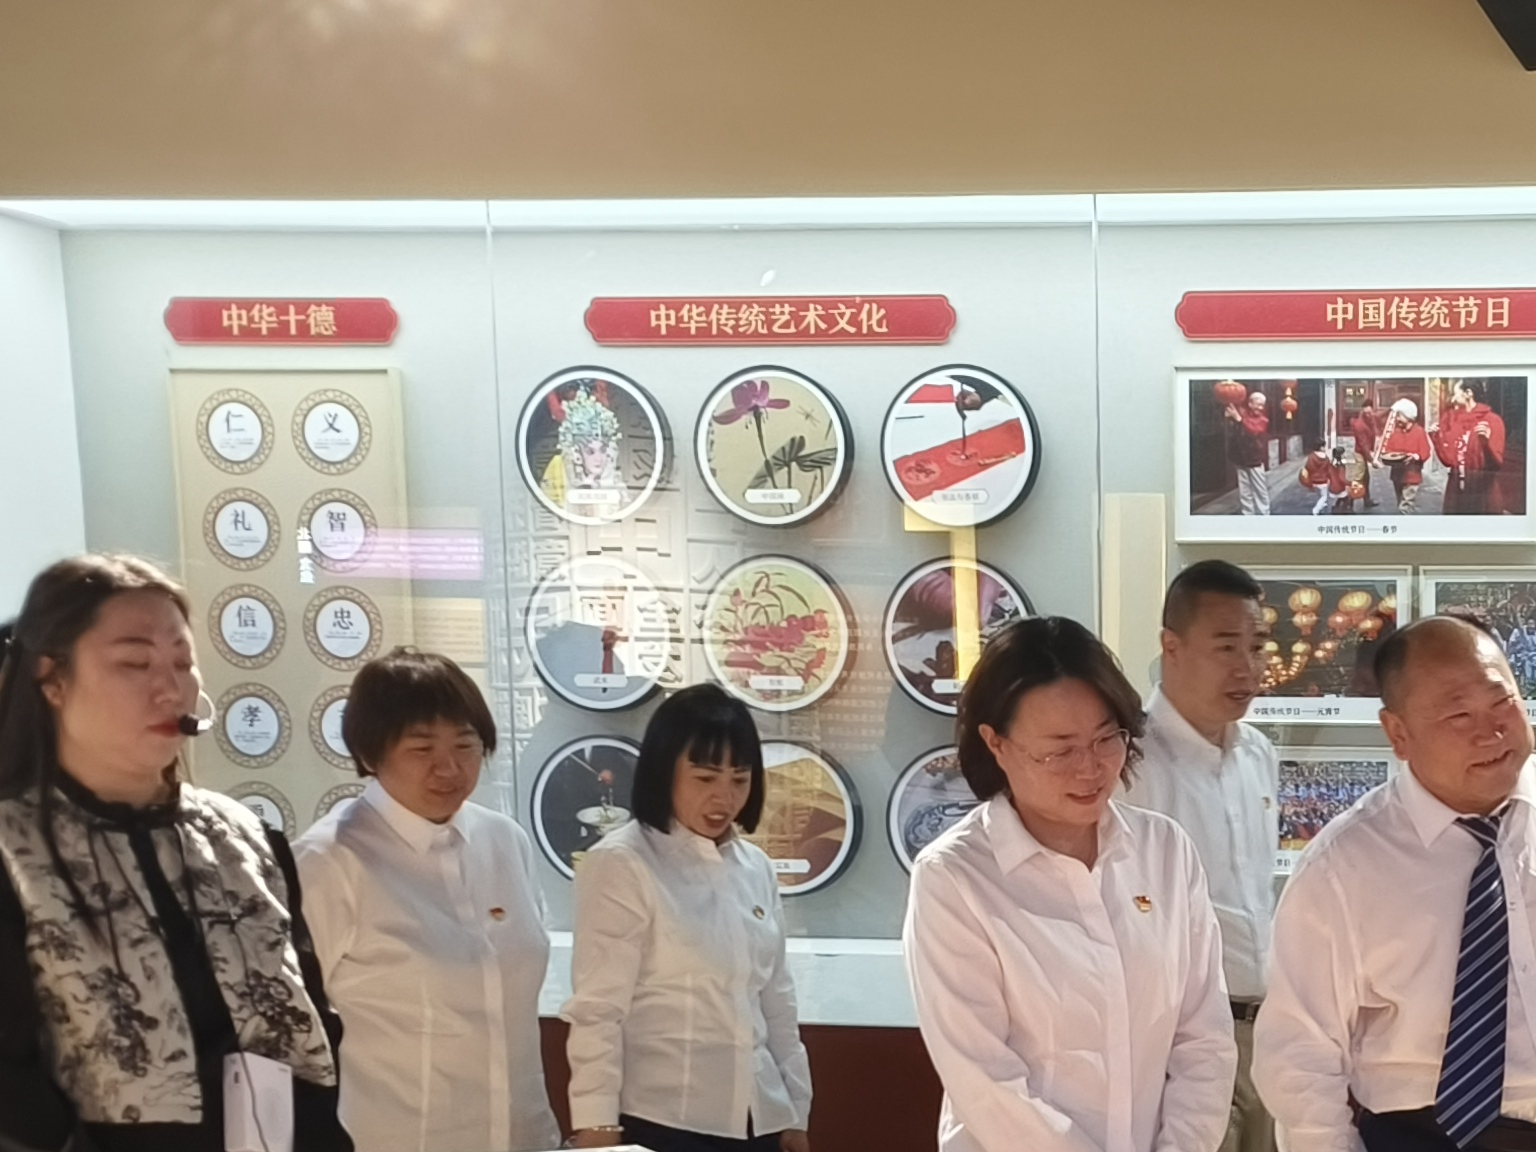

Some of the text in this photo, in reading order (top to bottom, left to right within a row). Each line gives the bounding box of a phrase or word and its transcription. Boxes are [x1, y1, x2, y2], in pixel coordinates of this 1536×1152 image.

[221, 303, 338, 336] 中华十德
[650, 302, 889, 335] 中华传统艺术文化
[1326, 296, 1511, 330] 中国传统节日
[225, 410, 247, 433] 仁
[321, 412, 342, 433] 义
[231, 509, 253, 531] 礼
[327, 510, 346, 532] 智
[237, 605, 257, 628] 信
[333, 607, 353, 630] 忠
[241, 704, 262, 727] 孝
